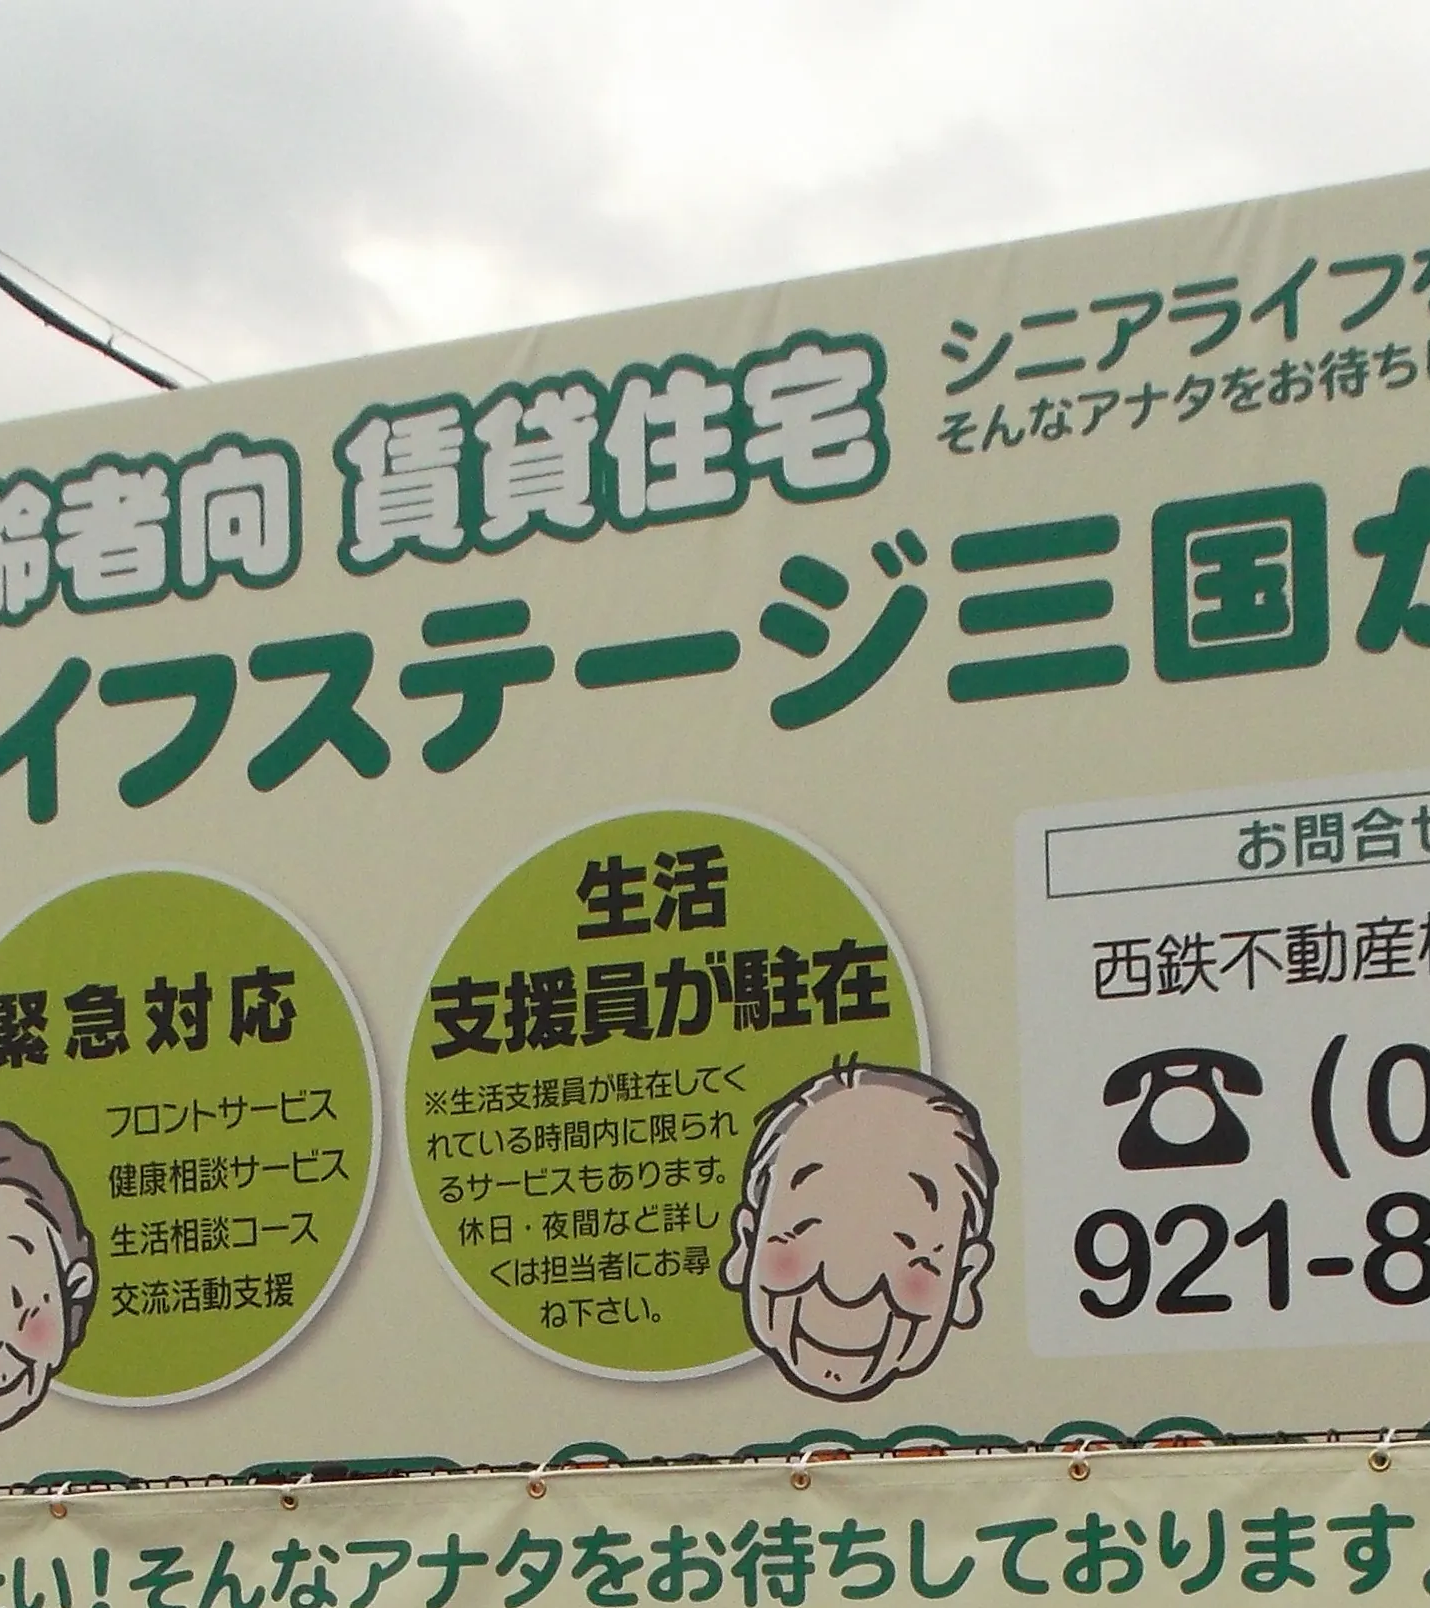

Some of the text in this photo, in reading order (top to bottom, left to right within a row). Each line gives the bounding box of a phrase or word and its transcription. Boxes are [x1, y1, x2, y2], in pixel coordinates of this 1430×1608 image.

[332, 328, 891, 577] 賃貸住宅
[575, 844, 729, 940] 生活
[429, 938, 891, 1060] 支援員が駐在
[105, 1089, 338, 1138] フロントサービス
[424, 1062, 748, 1116] ※生活支援員が駐在してく
[426, 1111, 738, 1160] れている時間内に限られ
[107, 1148, 350, 1200] 健康相談サービス
[440, 1155, 727, 1203] るサービスもあります。
[109, 1212, 320, 1258] 生活相談コース
[458, 1201, 720, 1247] 休日・夜間など詳し
[489, 1244, 711, 1287] くは担当者にお尋
[111, 1271, 295, 1318] 交流活動支援
[540, 1294, 663, 1330] ね下さい。
